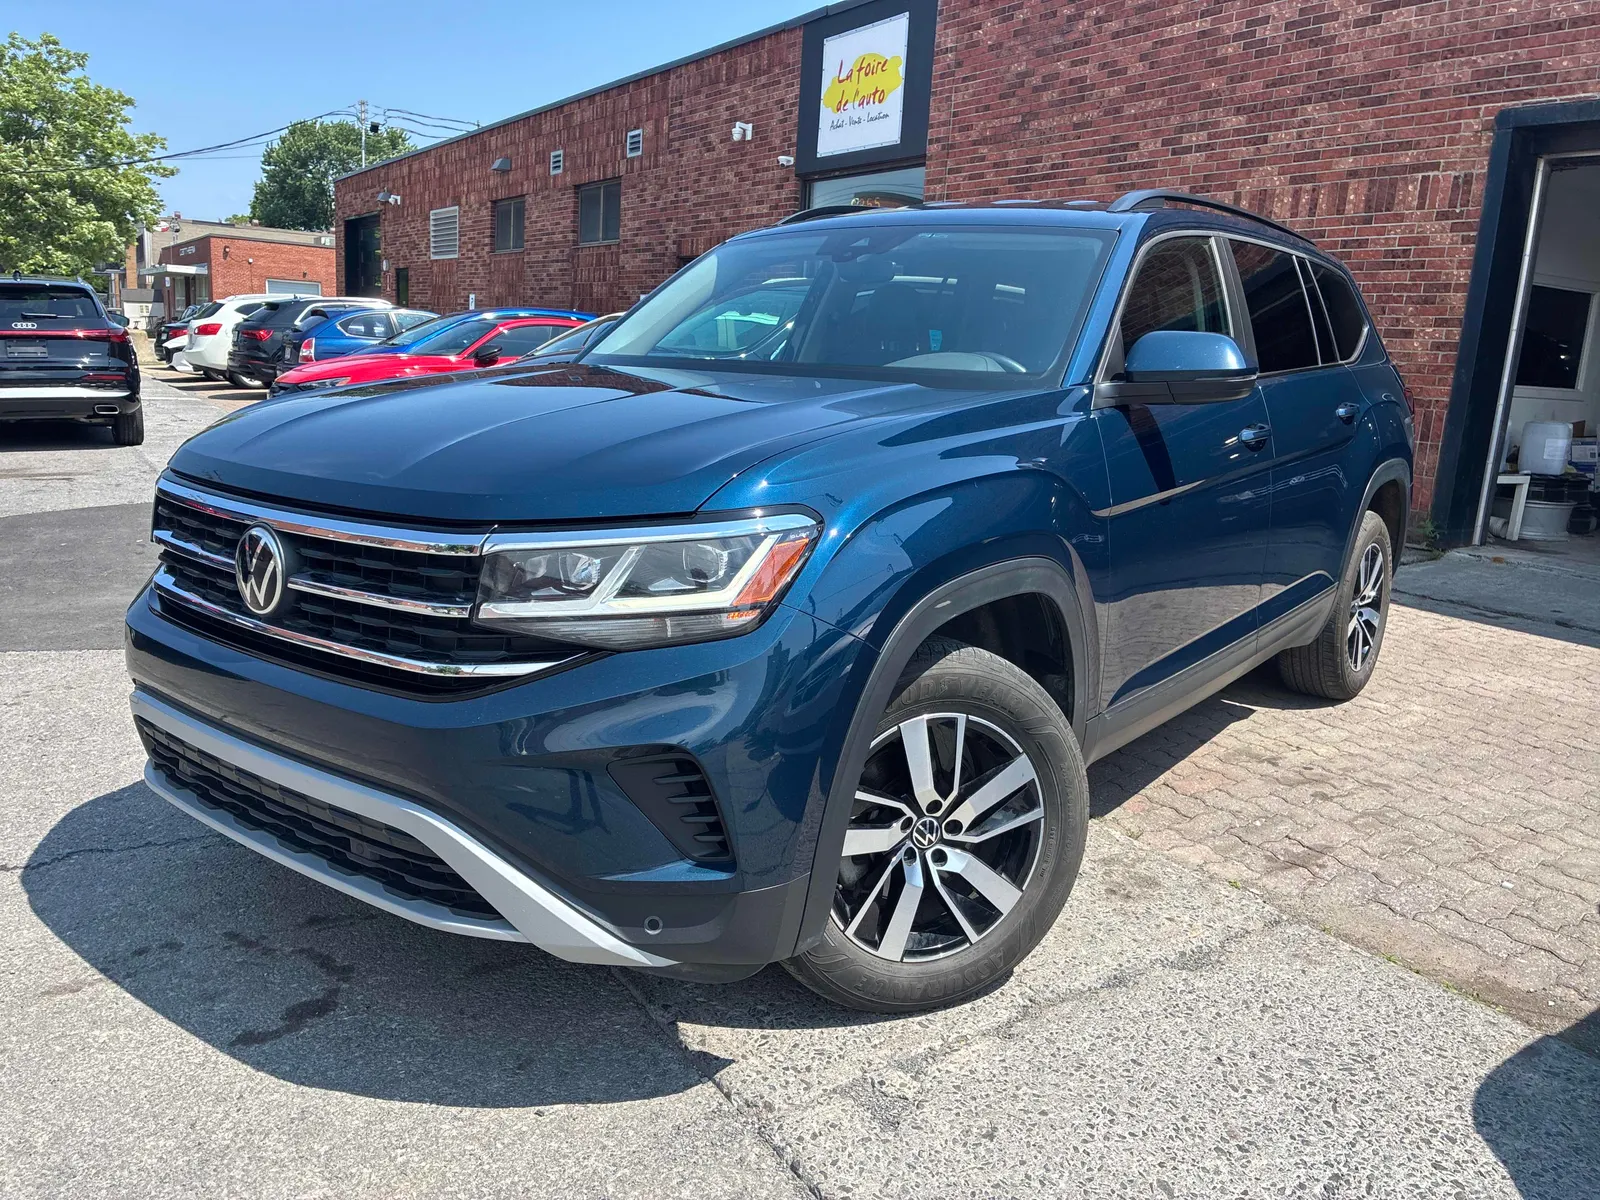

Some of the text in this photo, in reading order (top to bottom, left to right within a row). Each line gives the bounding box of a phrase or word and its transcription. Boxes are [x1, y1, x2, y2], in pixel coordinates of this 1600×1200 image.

[837, 57, 888, 85] La foire
[836, 86, 885, 113] de l'auto
[829, 119, 844, 131] Achat
[866, 112, 889, 122] Location
